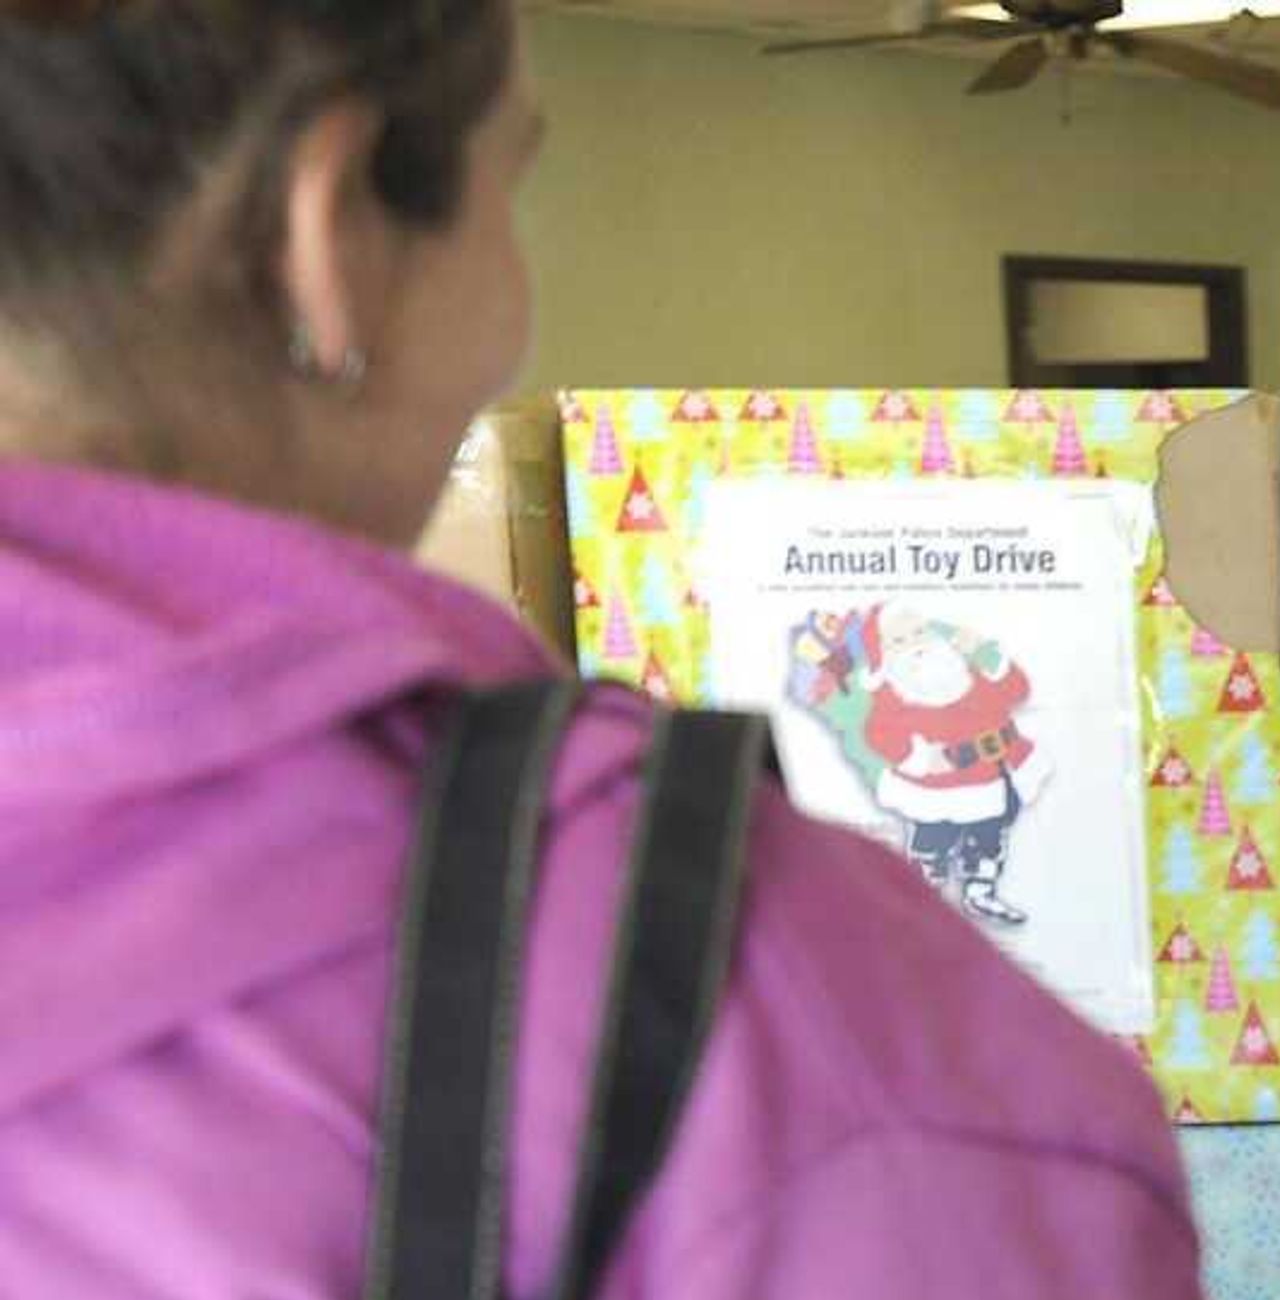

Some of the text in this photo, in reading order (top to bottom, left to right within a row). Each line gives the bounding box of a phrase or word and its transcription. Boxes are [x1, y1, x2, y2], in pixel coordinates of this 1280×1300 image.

[947, 526, 1029, 540] Department
[785, 544, 1056, 580] Annual Toy Drive
